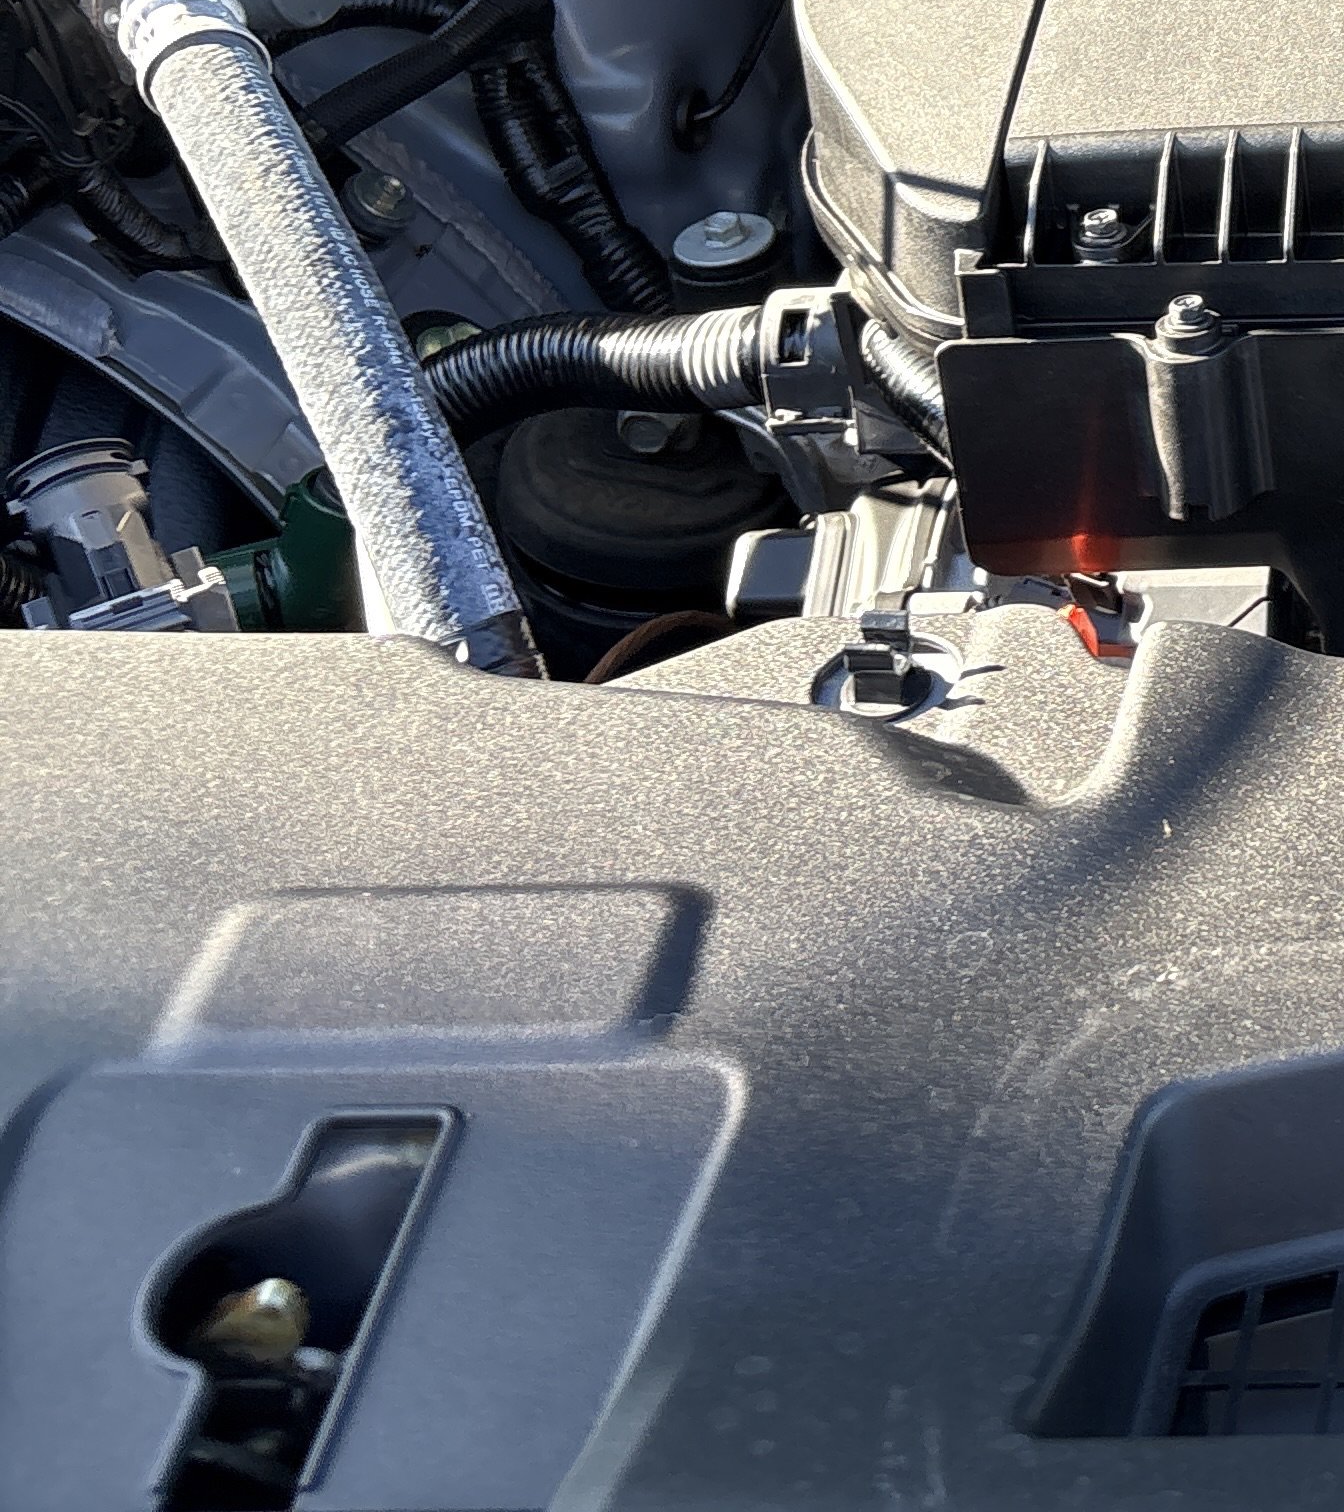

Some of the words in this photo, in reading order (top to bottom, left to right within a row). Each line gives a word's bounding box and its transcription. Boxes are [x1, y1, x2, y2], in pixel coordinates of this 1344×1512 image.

[348, 268, 381, 308] HOSE
[446, 477, 476, 528] EPDM
[467, 536, 492, 571] PET
